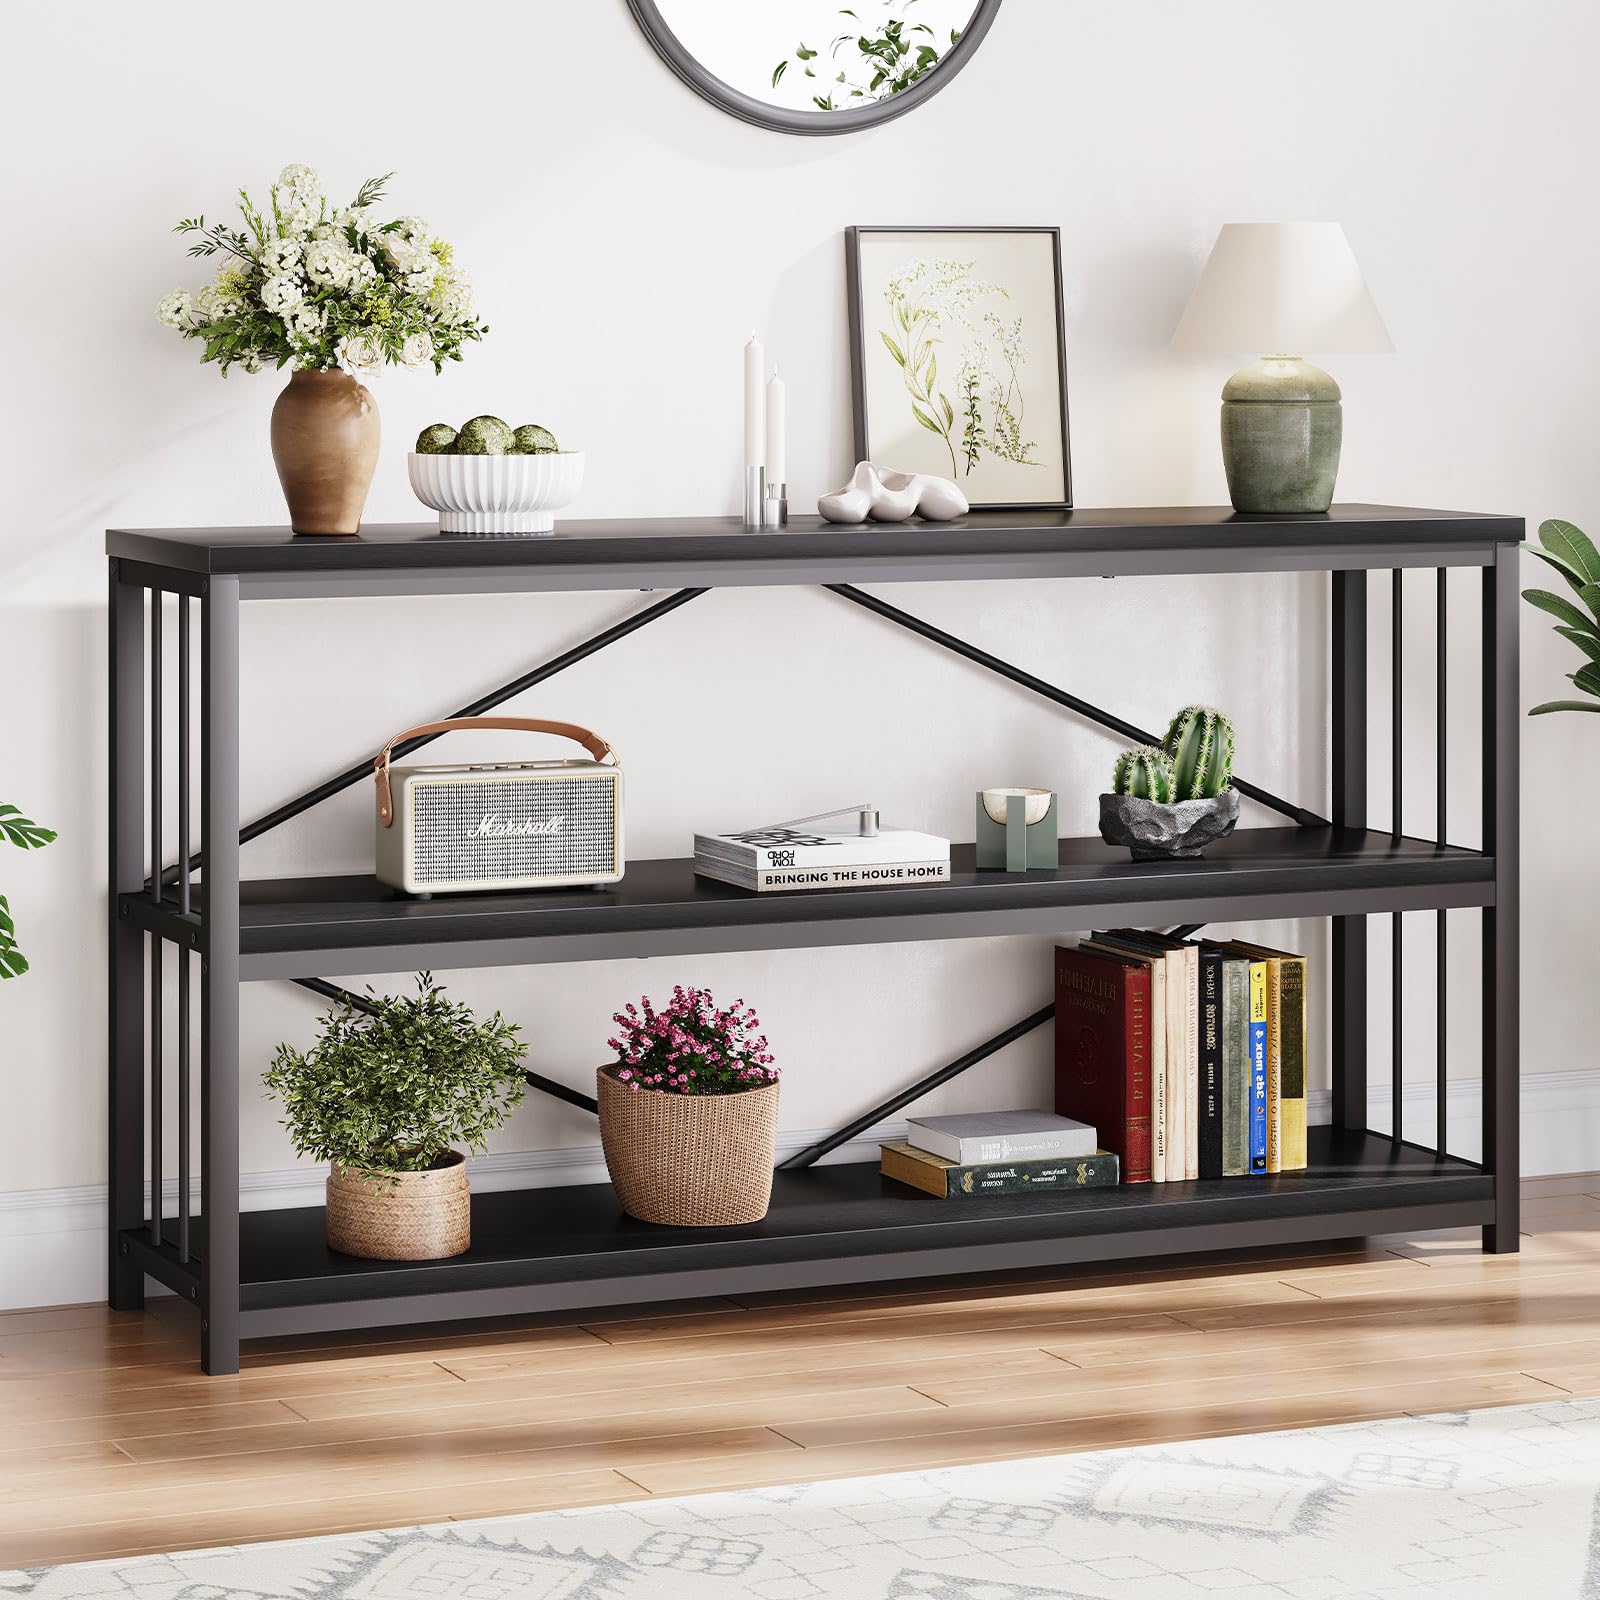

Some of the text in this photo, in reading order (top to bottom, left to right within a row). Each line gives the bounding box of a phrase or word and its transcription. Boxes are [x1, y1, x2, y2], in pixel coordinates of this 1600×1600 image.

[467, 813, 566, 838] Marshall
[767, 849, 795, 859] FORD
[772, 858, 795, 867] TOM
[765, 866, 944, 885] BRINGING THE HOUSE HOME
